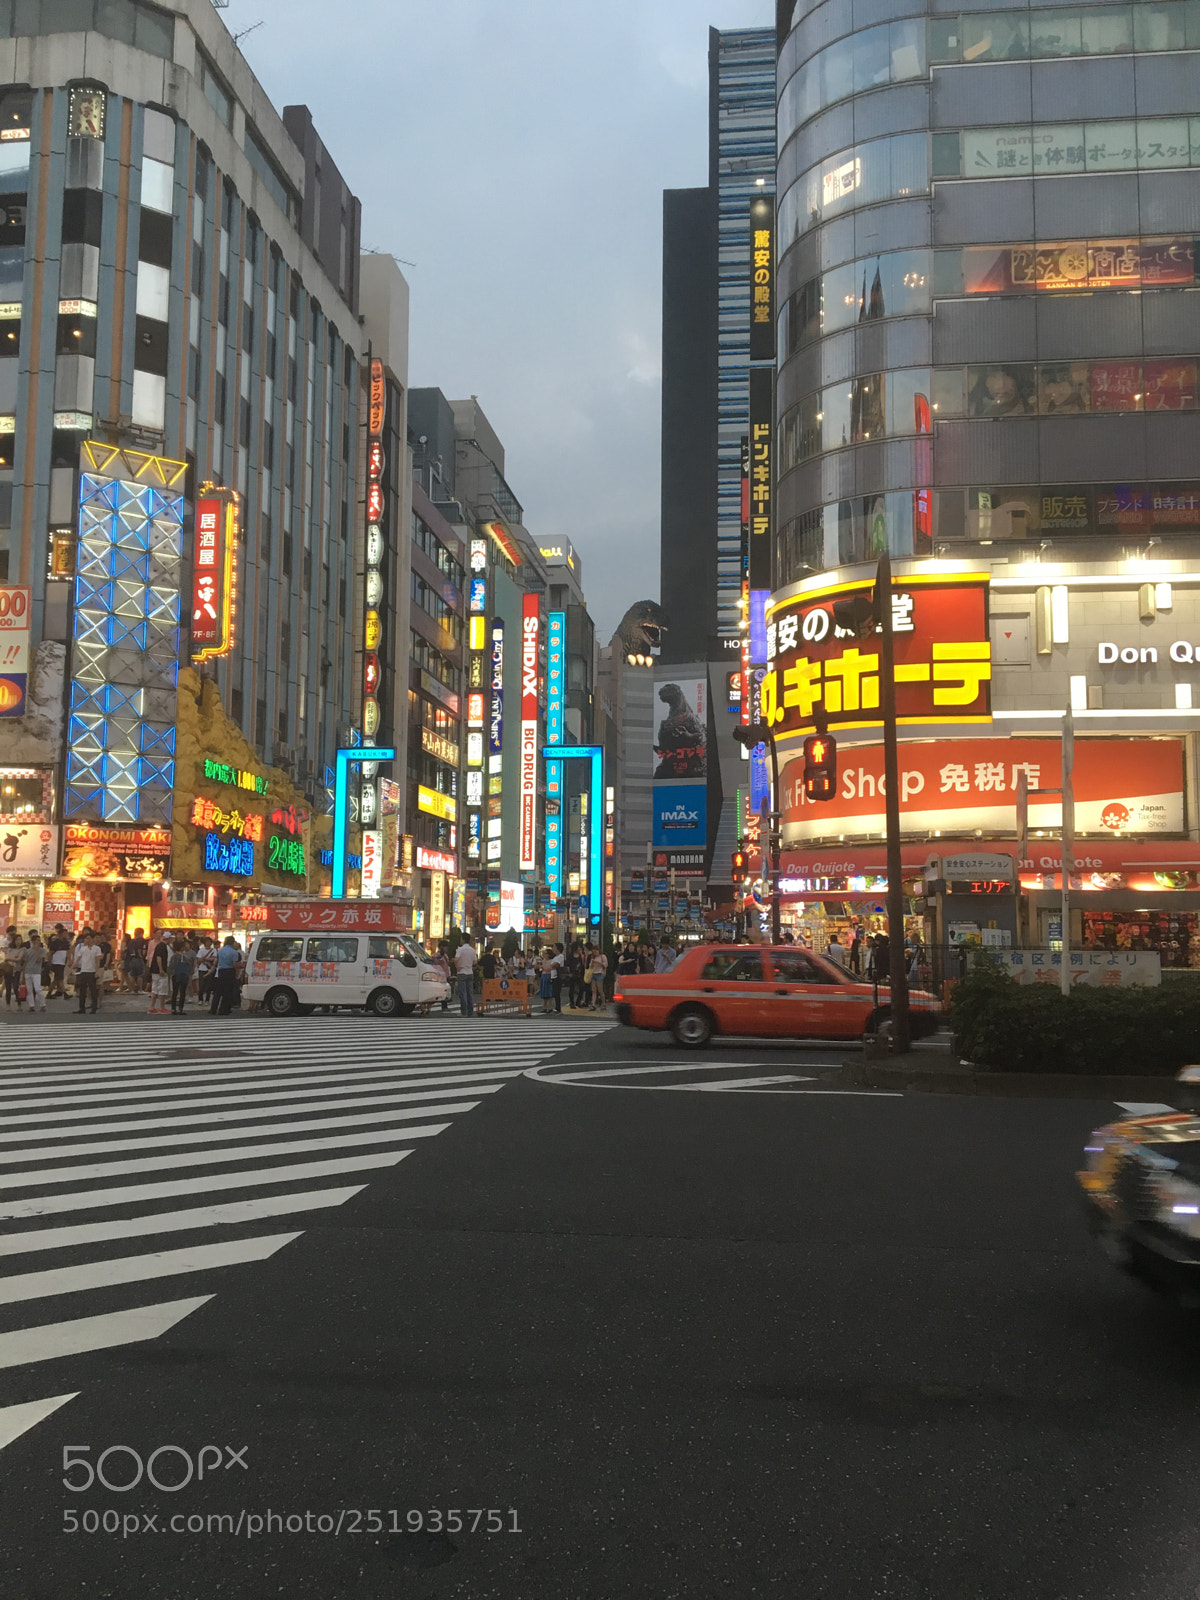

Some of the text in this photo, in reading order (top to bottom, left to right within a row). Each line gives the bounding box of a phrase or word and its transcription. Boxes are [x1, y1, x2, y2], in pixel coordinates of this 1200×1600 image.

[996, 134, 1054, 146] namco
[753, 230, 770, 323] 驚安の殿堂
[1042, 496, 1087, 519] 販売
[1097, 499, 1142, 512] ブランド
[198, 513, 216, 566] 居酒屋
[523, 616, 539, 697] SHIDAX
[1098, 641, 1159, 664] Don
[523, 727, 534, 790] BIC DRUG
[939, 761, 1041, 793] 免税店
[661, 810, 699, 821] IMAX
[1140, 804, 1167, 812] Japan.
[1147, 820, 1167, 829] Shop
[66, 827, 172, 843] OKONOMI YAKI
[363, 834, 376, 879] トラノコ
[786, 860, 856, 875] Don Quijote
[275, 908, 382, 925] マック赤坂
